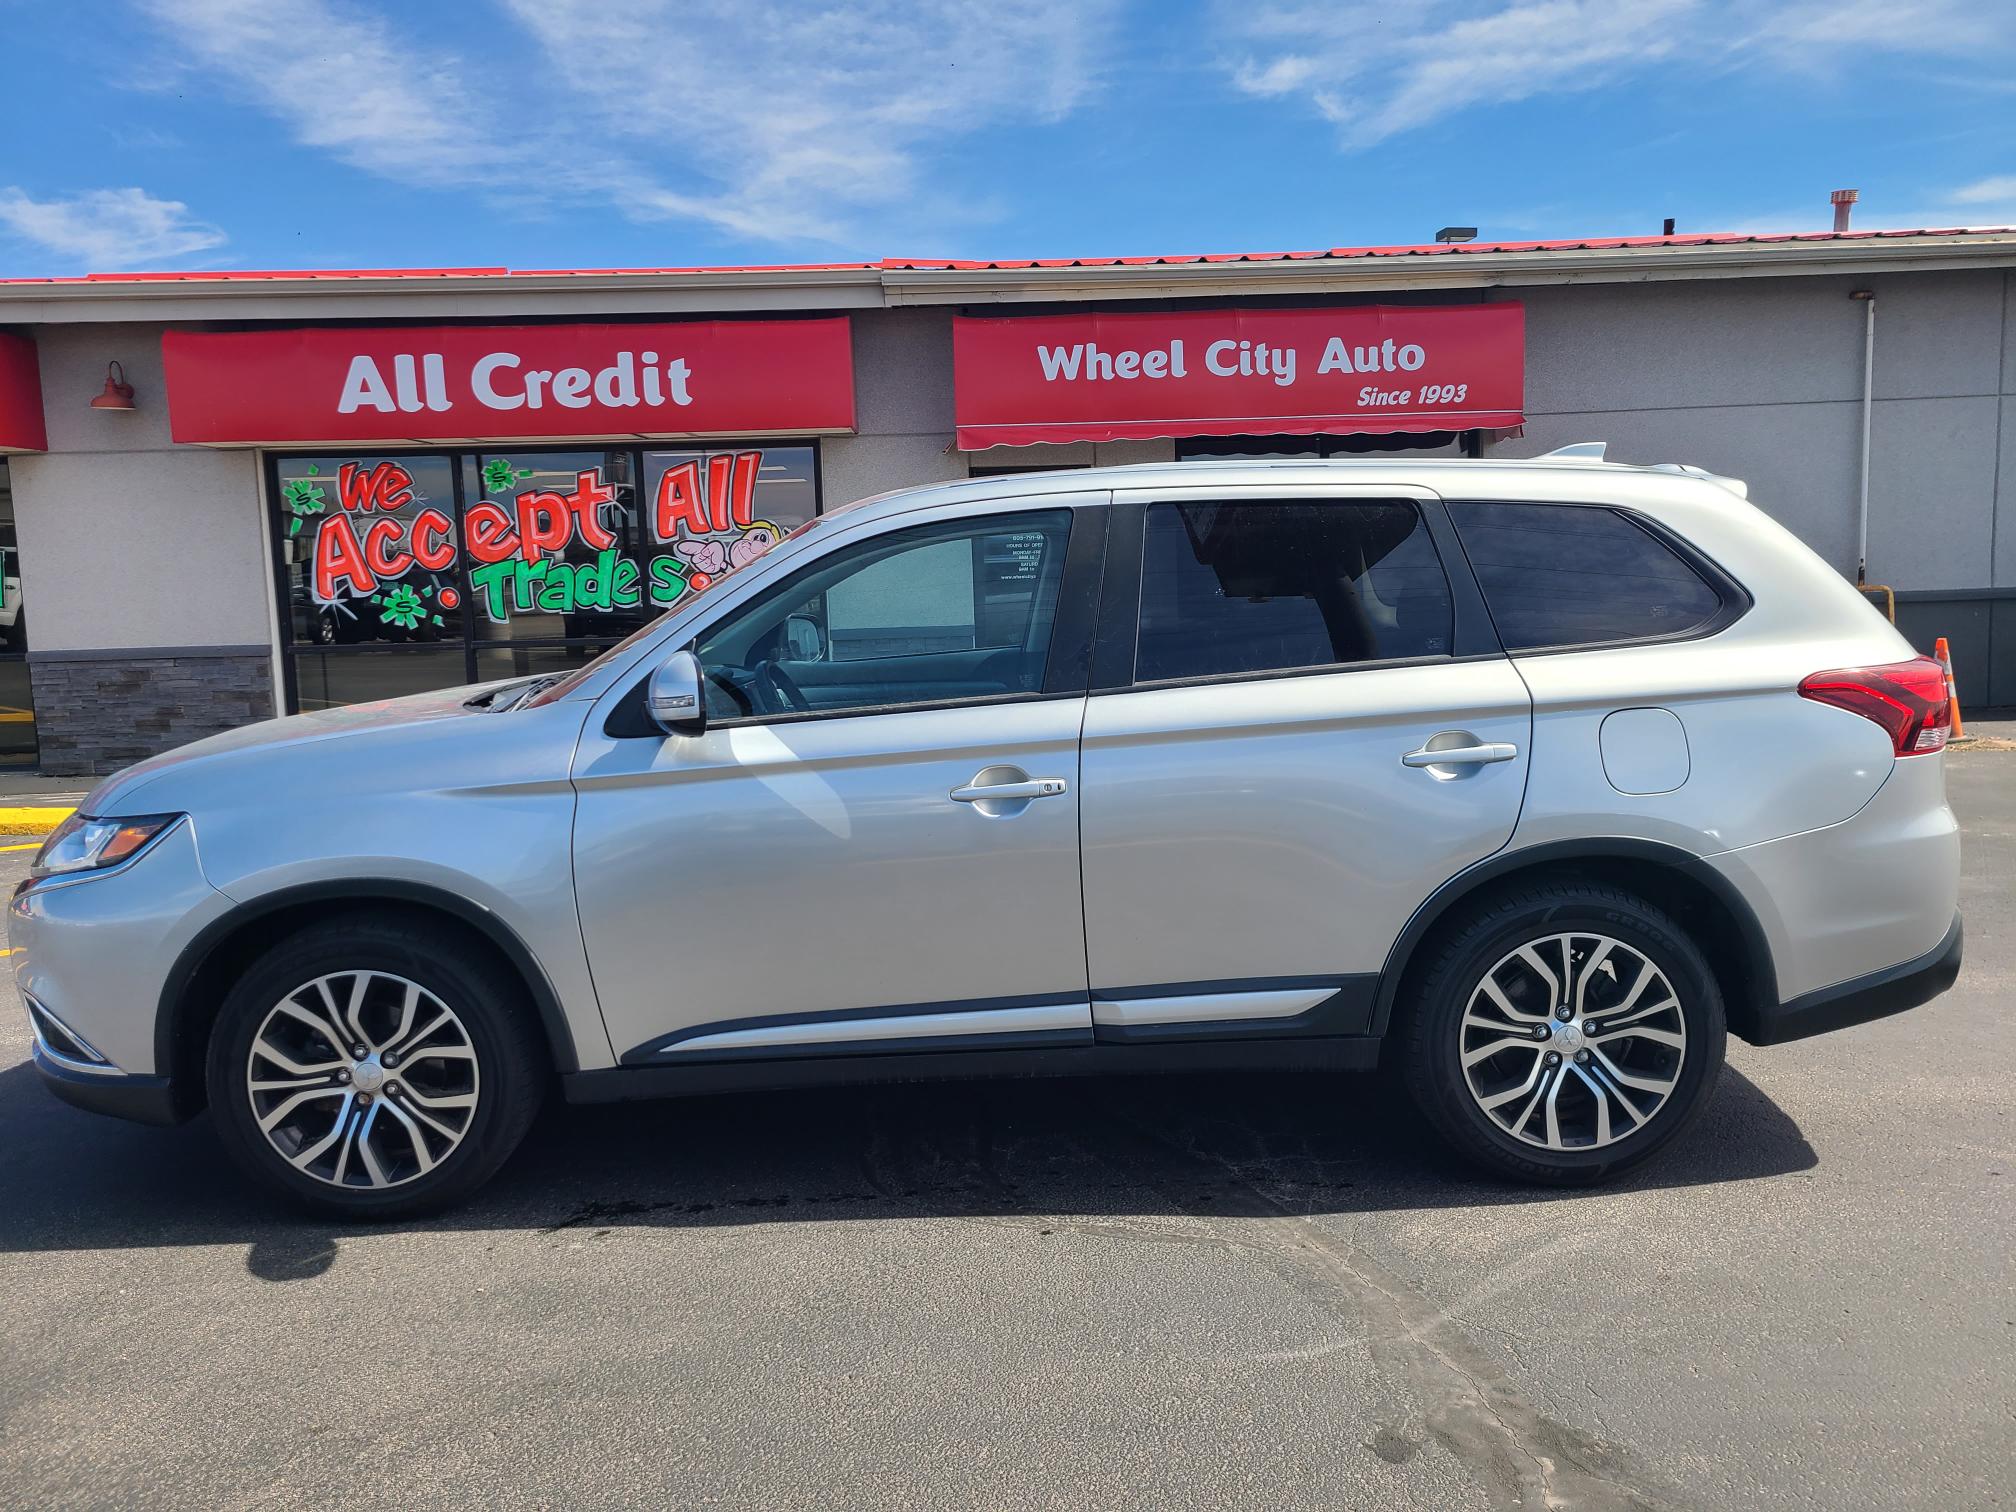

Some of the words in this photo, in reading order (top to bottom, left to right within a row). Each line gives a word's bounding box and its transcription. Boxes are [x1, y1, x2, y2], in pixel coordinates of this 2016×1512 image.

[337, 353, 453, 414] All
[471, 351, 693, 410] Credit
[1037, 340, 1187, 381] Wheel
[1205, 339, 1297, 386] City
[1317, 337, 1425, 375] Auto
[1357, 387, 1410, 407] Since
[1418, 384, 1467, 404] 1993
[337, 461, 415, 514] We
[312, 467, 617, 604] Accept
[654, 451, 763, 543] All
[470, 549, 687, 624] Trades
